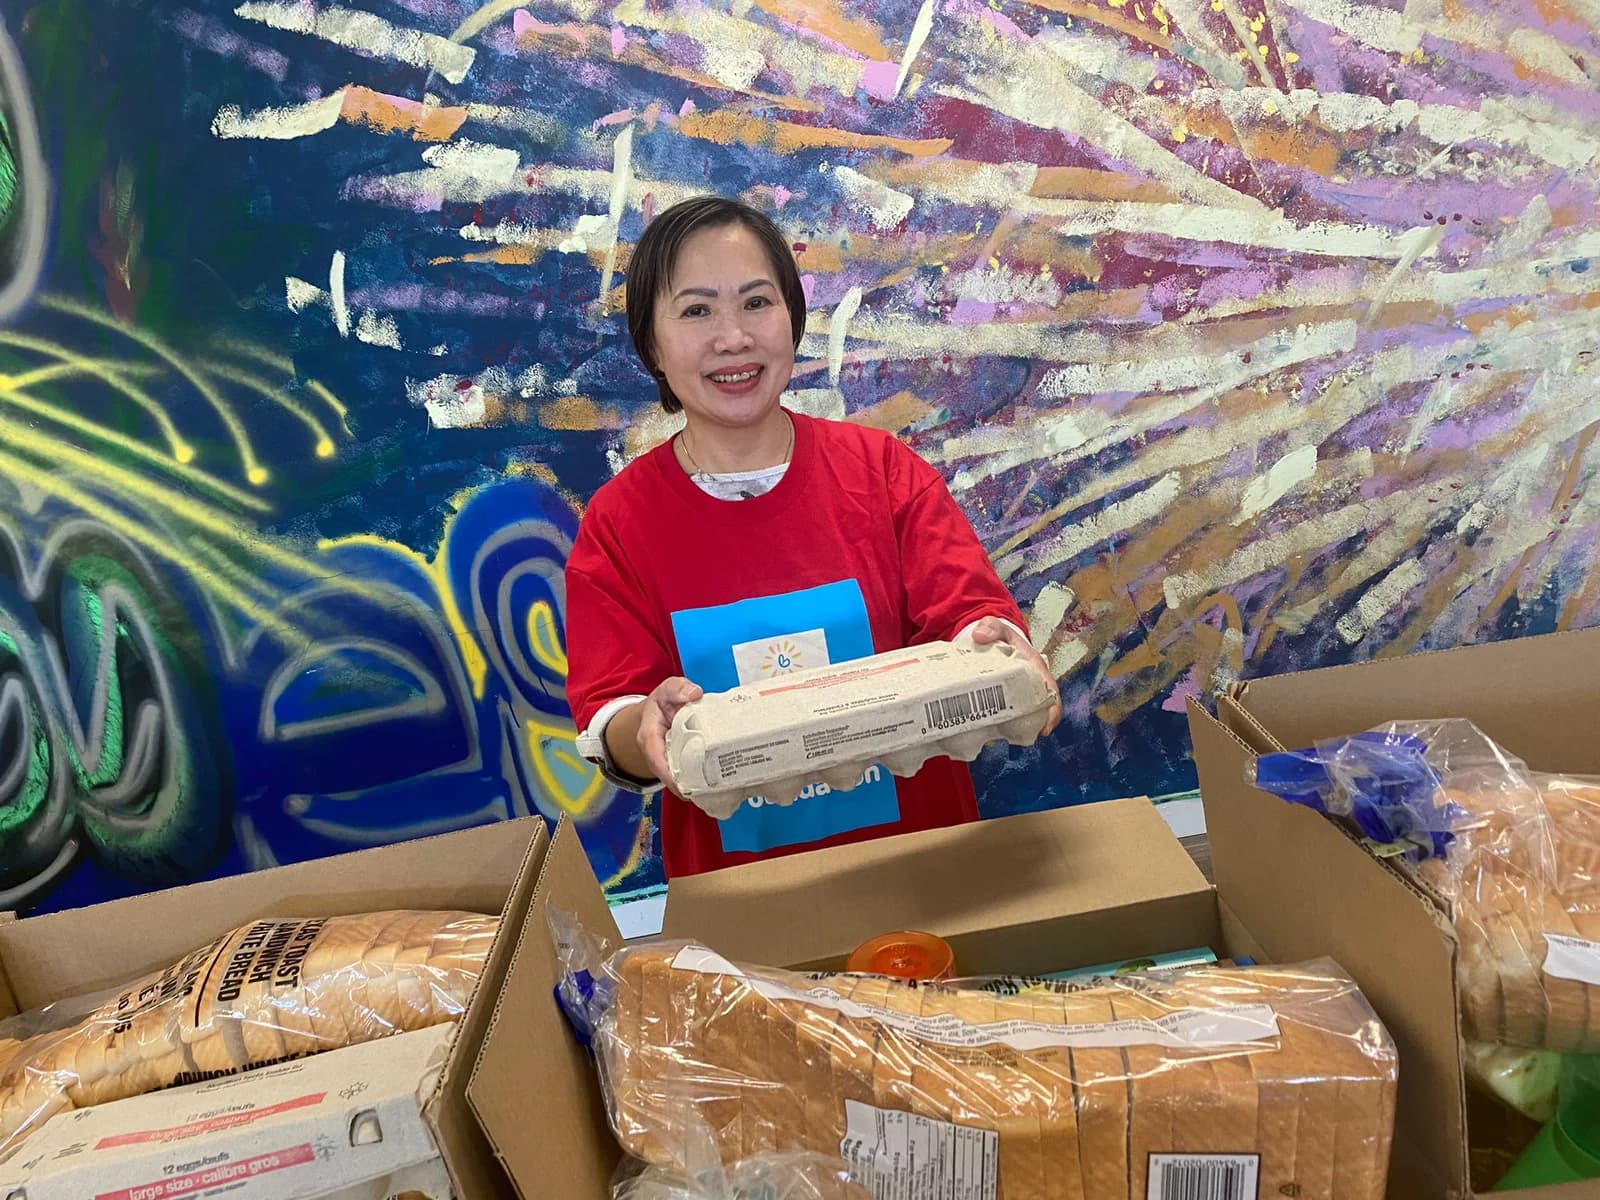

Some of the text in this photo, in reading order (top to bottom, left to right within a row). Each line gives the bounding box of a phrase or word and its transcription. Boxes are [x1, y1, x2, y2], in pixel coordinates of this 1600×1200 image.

[937, 716, 966, 730] 60383
[970, 709, 998, 722] 66414
[248, 922, 301, 984] SANDWICH
[275, 942, 312, 988] TOAST
[217, 951, 256, 1002] BREAD
[129, 1182, 163, 1200] large
[166, 1174, 193, 1192] size
[202, 1164, 247, 1185] calibre
[249, 1156, 280, 1174] gros
[162, 1165, 176, 1176] 12
